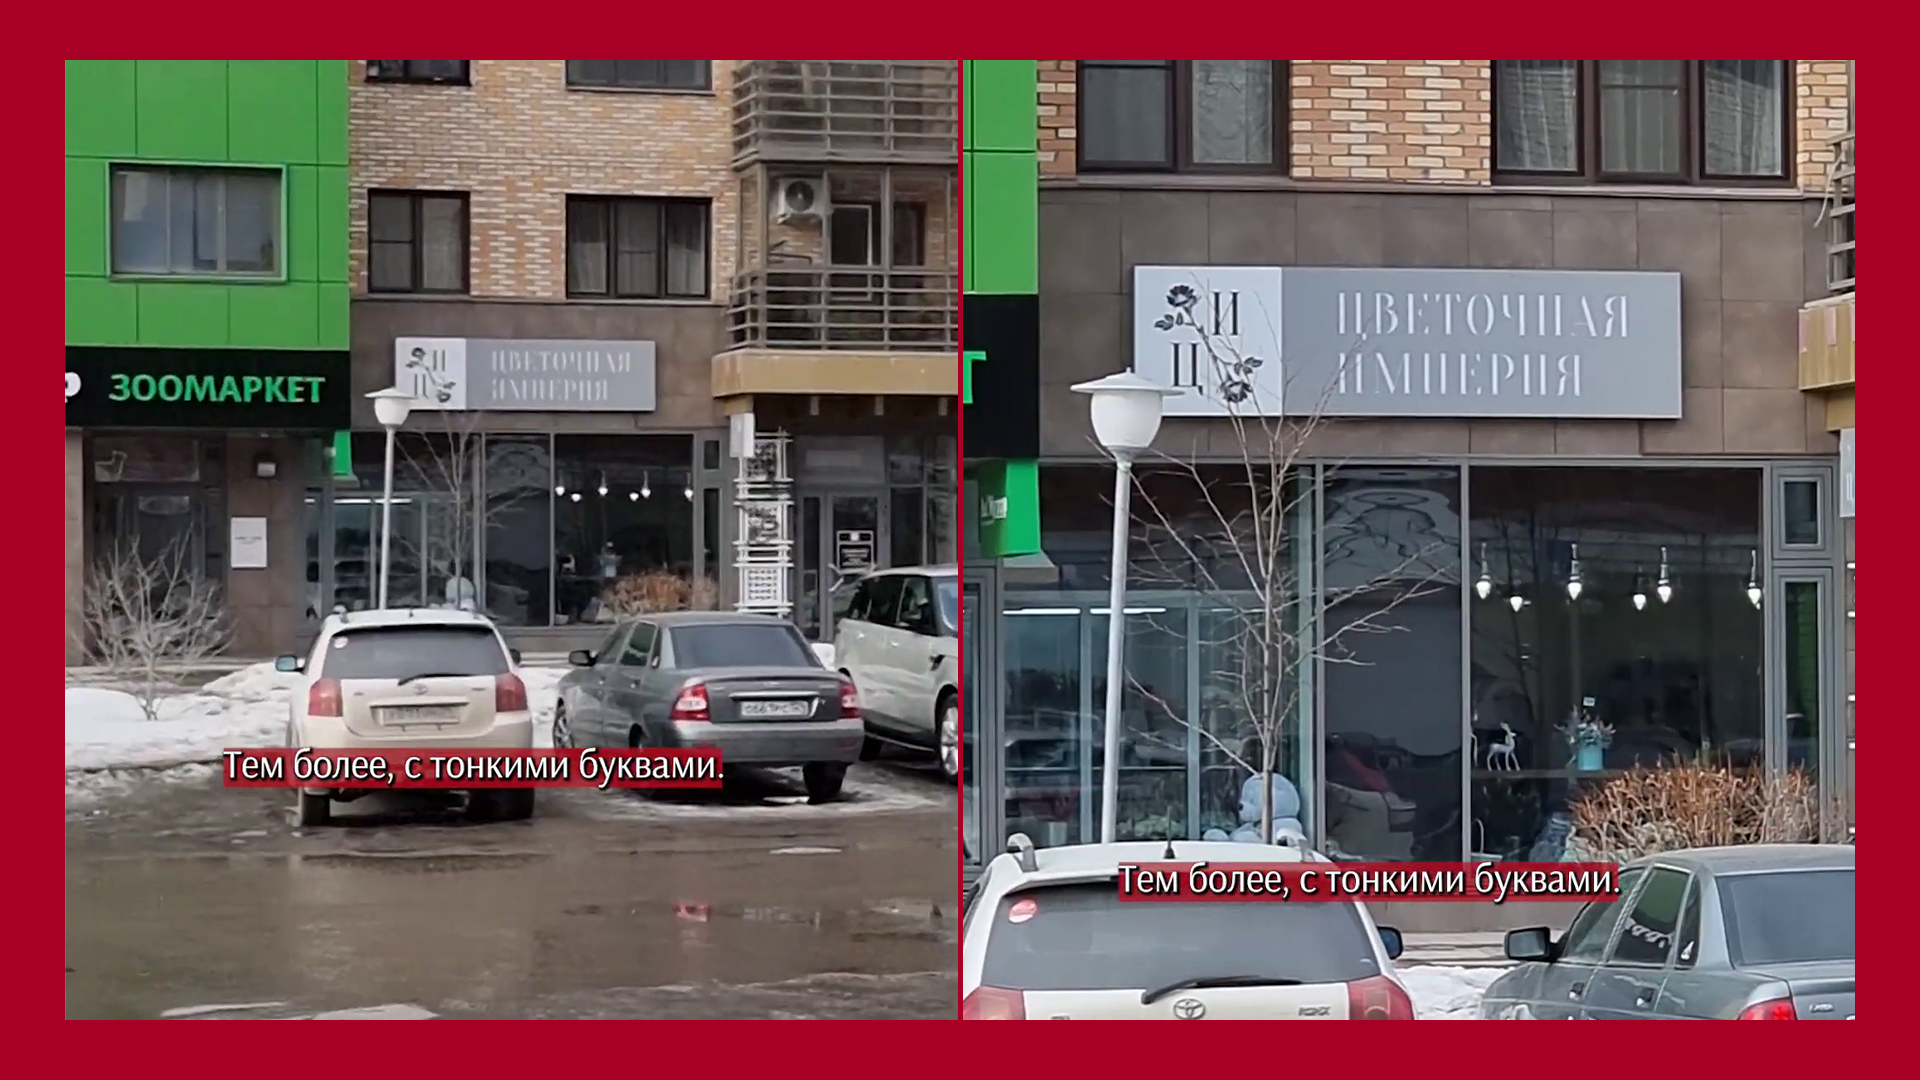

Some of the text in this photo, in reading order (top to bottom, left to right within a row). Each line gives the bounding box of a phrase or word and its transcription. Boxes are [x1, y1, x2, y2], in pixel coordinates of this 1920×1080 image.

[1337, 292, 1630, 341] ЦВЕТОЧНАЯ
[491, 350, 632, 376] ЦВЕТОЧНАЯ
[1337, 352, 1582, 396] ИМПЕРИЯ
[108, 373, 327, 403] ЗООМАРКЕТ
[491, 378, 609, 401] ИМПЕРИЯ
